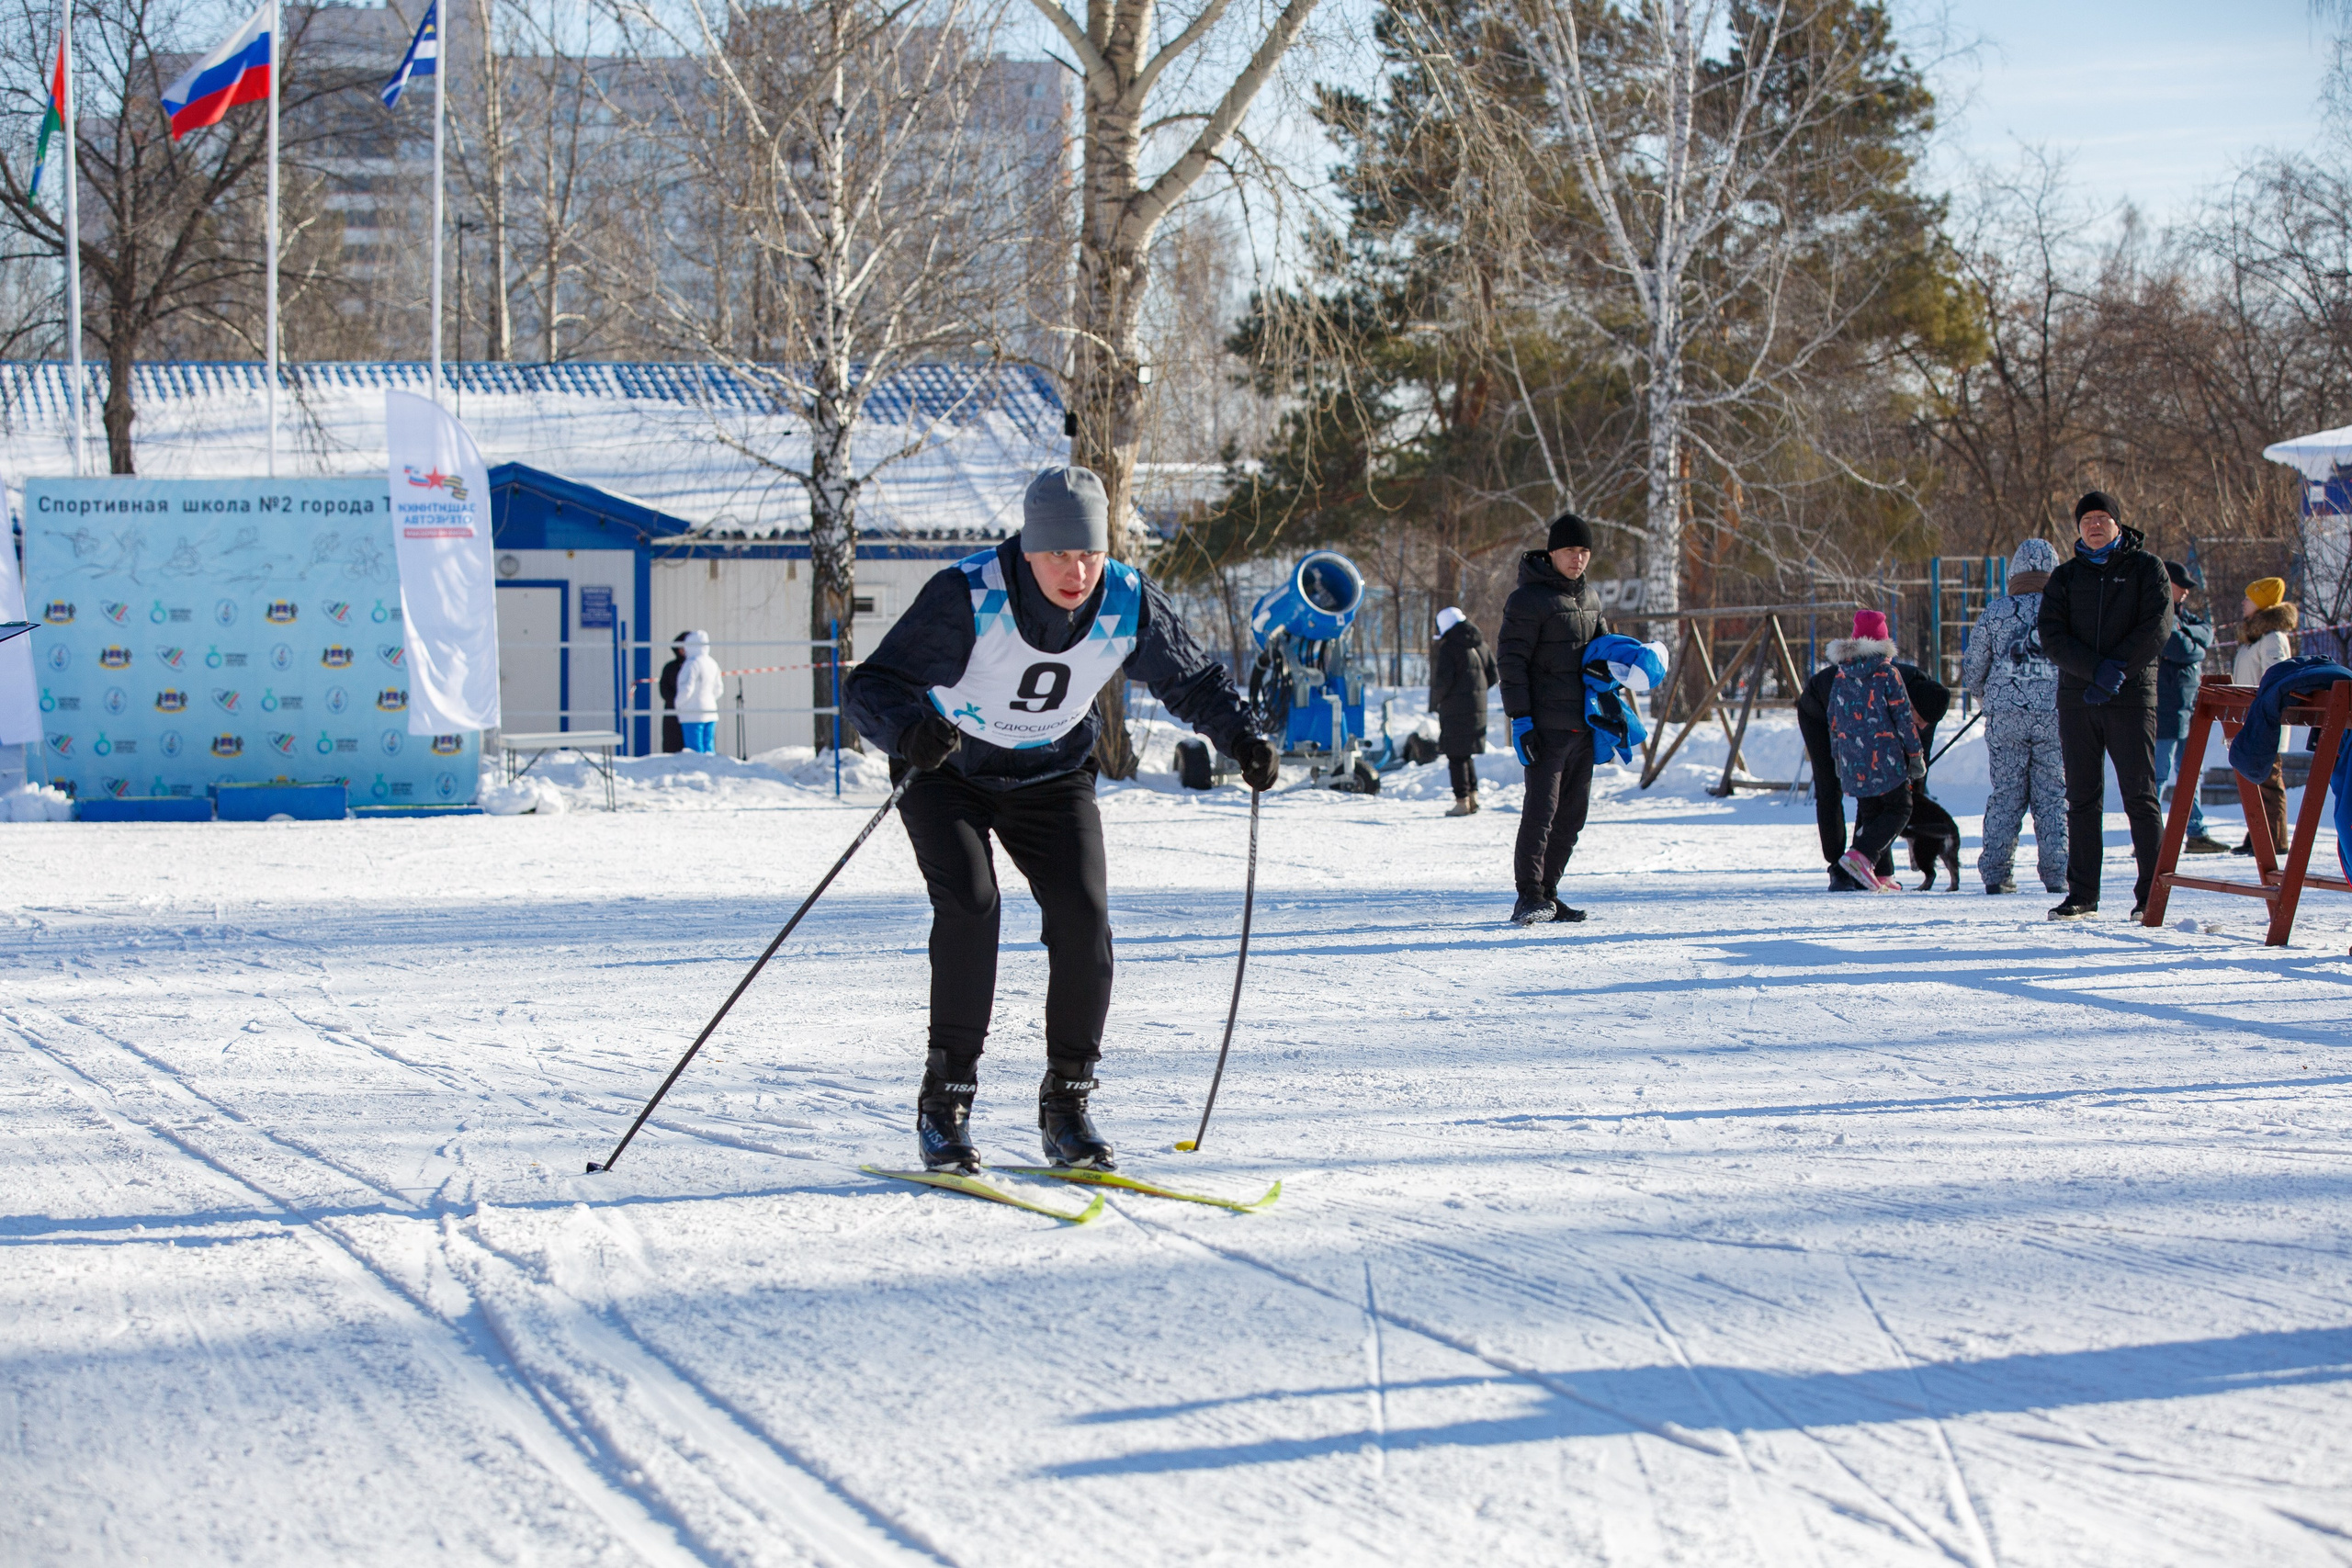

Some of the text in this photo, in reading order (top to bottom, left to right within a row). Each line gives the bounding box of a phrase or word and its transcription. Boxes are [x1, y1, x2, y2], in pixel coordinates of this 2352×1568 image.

[38, 495, 169, 517] Спортивная
[183, 499, 251, 513] школа
[259, 495, 292, 513] №2
[300, 499, 375, 516] города
[1009, 661, 1072, 714] 9
[993, 718, 1068, 732] СДЮСШОР
[944, 1082, 977, 1092] TISA
[1065, 1080, 1094, 1090] TISA
